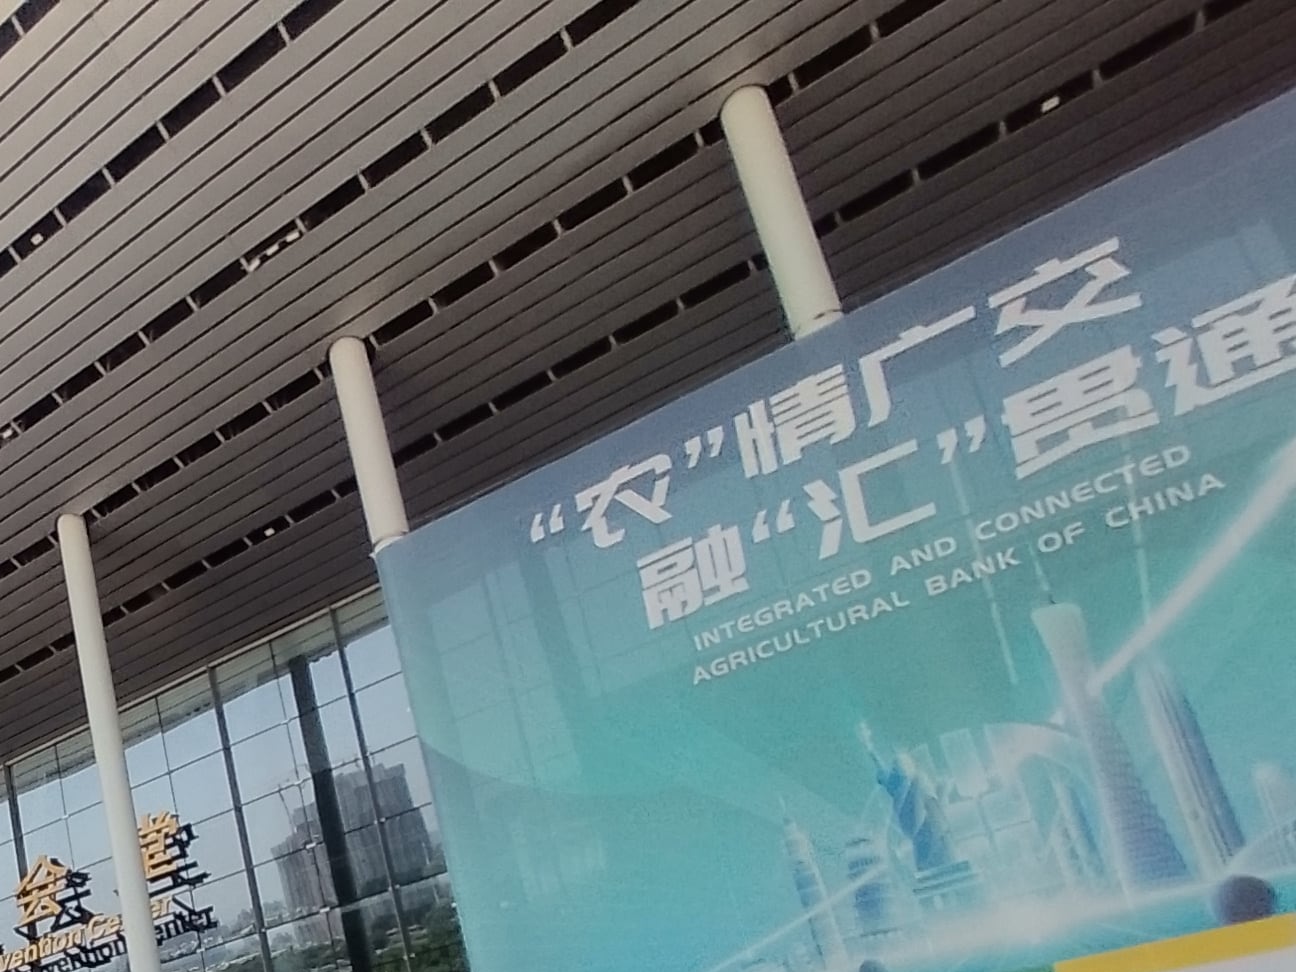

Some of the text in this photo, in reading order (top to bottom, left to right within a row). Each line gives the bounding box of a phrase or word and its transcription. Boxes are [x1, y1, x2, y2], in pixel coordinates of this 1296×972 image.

[692, 472, 1227, 686] AGRICULTURAL BANK OF CHINA
[693, 444, 1192, 651] INTEGRATED AND CONNECTED
